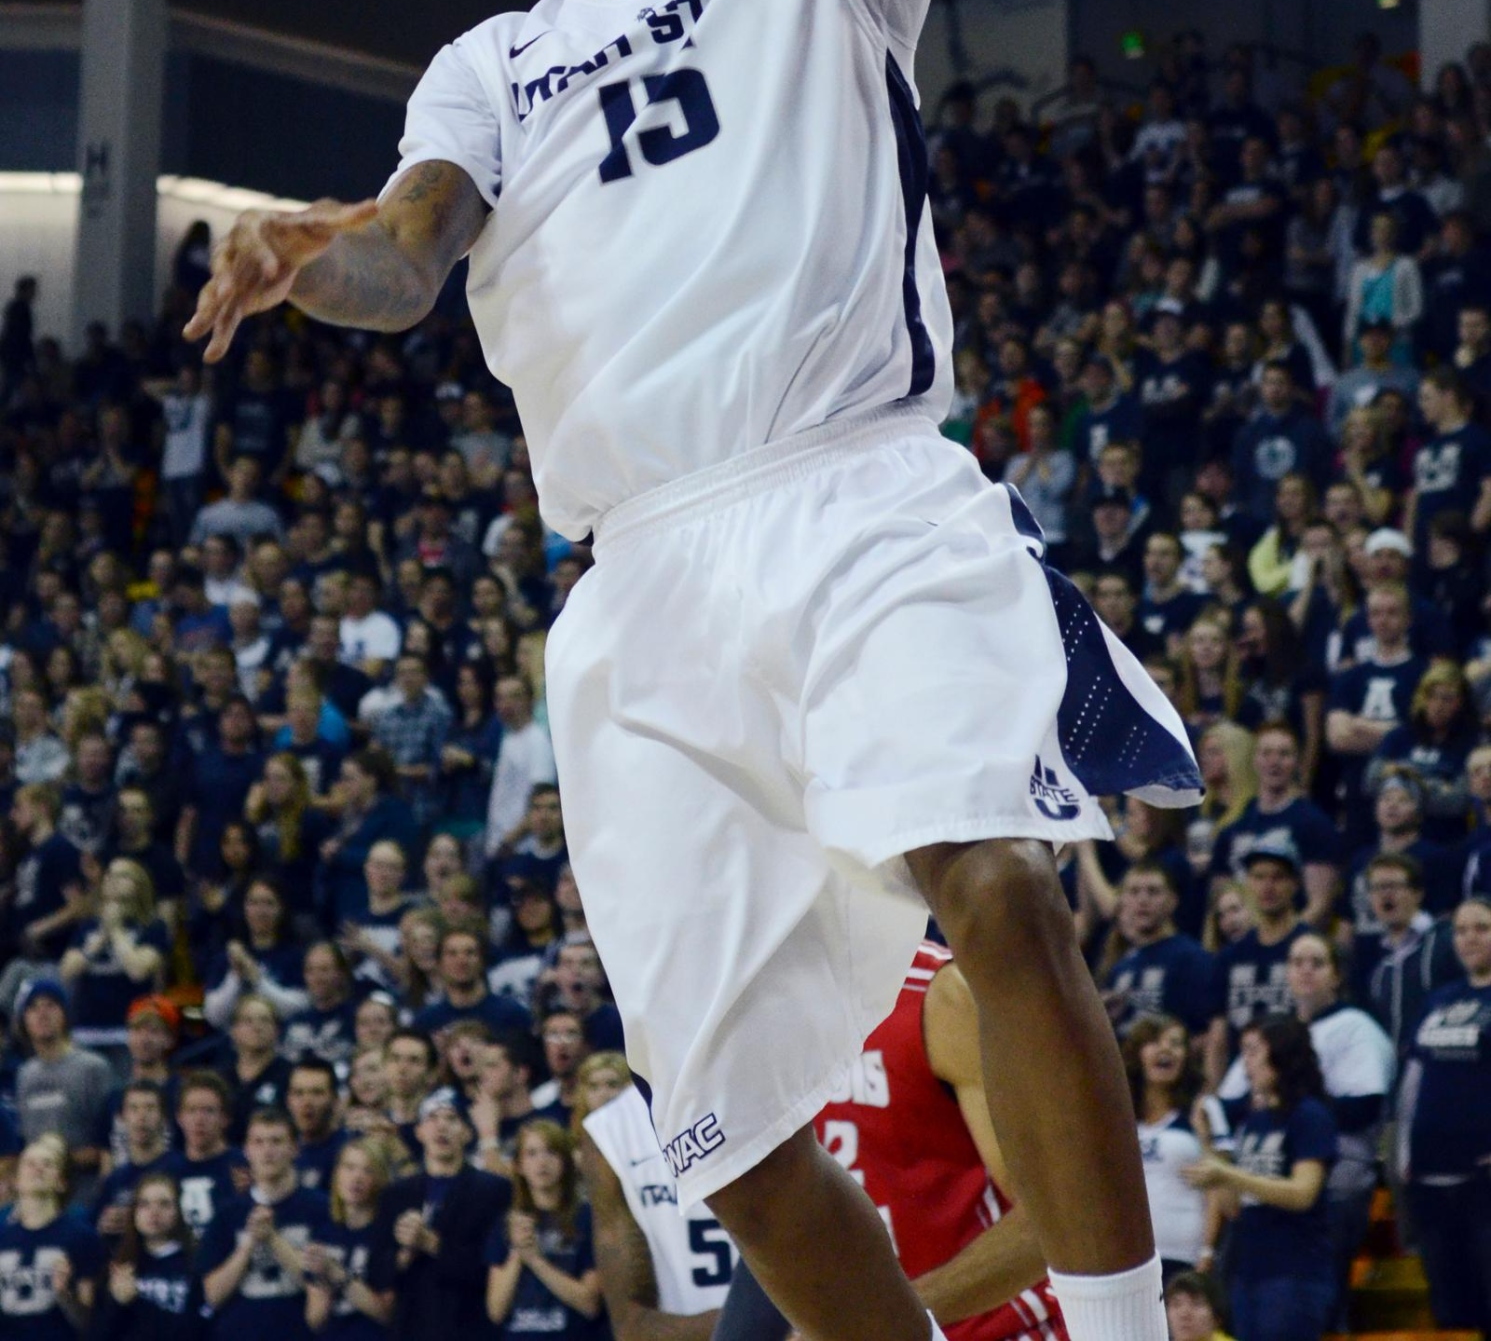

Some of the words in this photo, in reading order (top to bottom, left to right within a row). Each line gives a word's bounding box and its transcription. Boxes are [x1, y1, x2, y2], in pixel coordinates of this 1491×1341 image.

[598, 67, 720, 184] 15
[1030, 774, 1080, 804] STATE
[662, 1112, 726, 1178] WAC
[687, 1218, 732, 1288] 5
